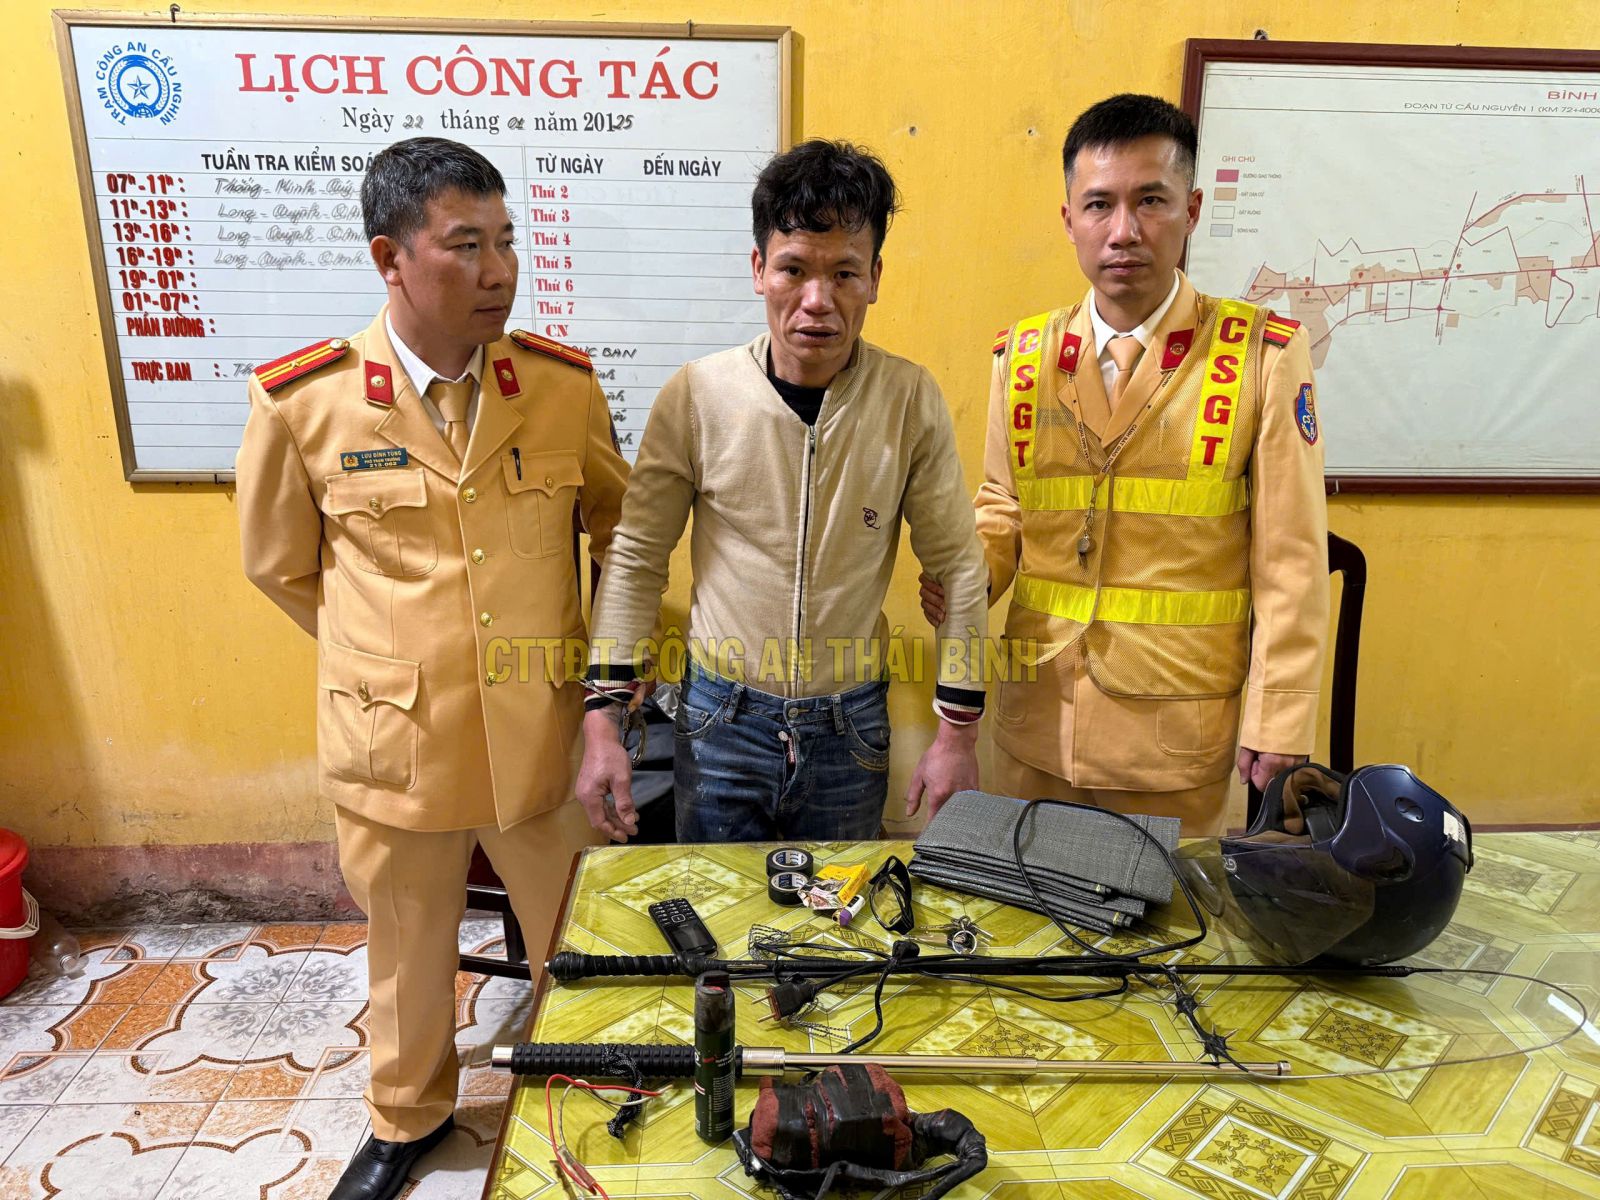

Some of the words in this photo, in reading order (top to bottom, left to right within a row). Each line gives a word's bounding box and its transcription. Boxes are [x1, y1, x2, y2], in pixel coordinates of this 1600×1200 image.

[127, 41, 147, 53] AN
[96, 45, 123, 80] CÔNG
[151, 49, 178, 76] CẦU
[235, 53, 388, 102] LỊCH
[405, 44, 582, 99] CÔNG
[600, 46, 719, 100] TÁC
[97, 87, 126, 126] TRẠM
[160, 82, 182, 126] NGHÌN
[1547, 90, 1597, 100] BÌNH
[341, 107, 394, 133] Ngày
[402, 114, 424, 130] 22
[440, 108, 500, 135] tháng
[534, 110, 578, 131] năm
[201, 147, 250, 170] TUẦN
[255, 154, 290, 171] TRA
[294, 146, 336, 172] KIỂM
[341, 152, 373, 172] SOÁ
[536, 153, 557, 173] TỪ
[561, 154, 603, 174] NGÀY
[643, 153, 674, 176] ĐẾN
[679, 156, 721, 177] NGÀY
[530, 184, 555, 199] Thứ
[560, 185, 568, 199] 2
[531, 208, 556, 222] Thứ
[561, 209, 570, 223] 3
[532, 232, 557, 245] Thứ
[563, 232, 571, 246] 4
[534, 255, 559, 269] Thứ
[564, 256, 572, 269] 5
[535, 278, 560, 292] Thứ
[565, 279, 574, 292] 6
[537, 301, 562, 314] Thứ
[567, 302, 575, 315] 7
[545, 324, 569, 338] CN
[132, 360, 163, 384] TRỰC
[165, 362, 192, 381] BAN
[1013, 328, 1041, 468] CSGT
[1200, 316, 1248, 466] CSGT
